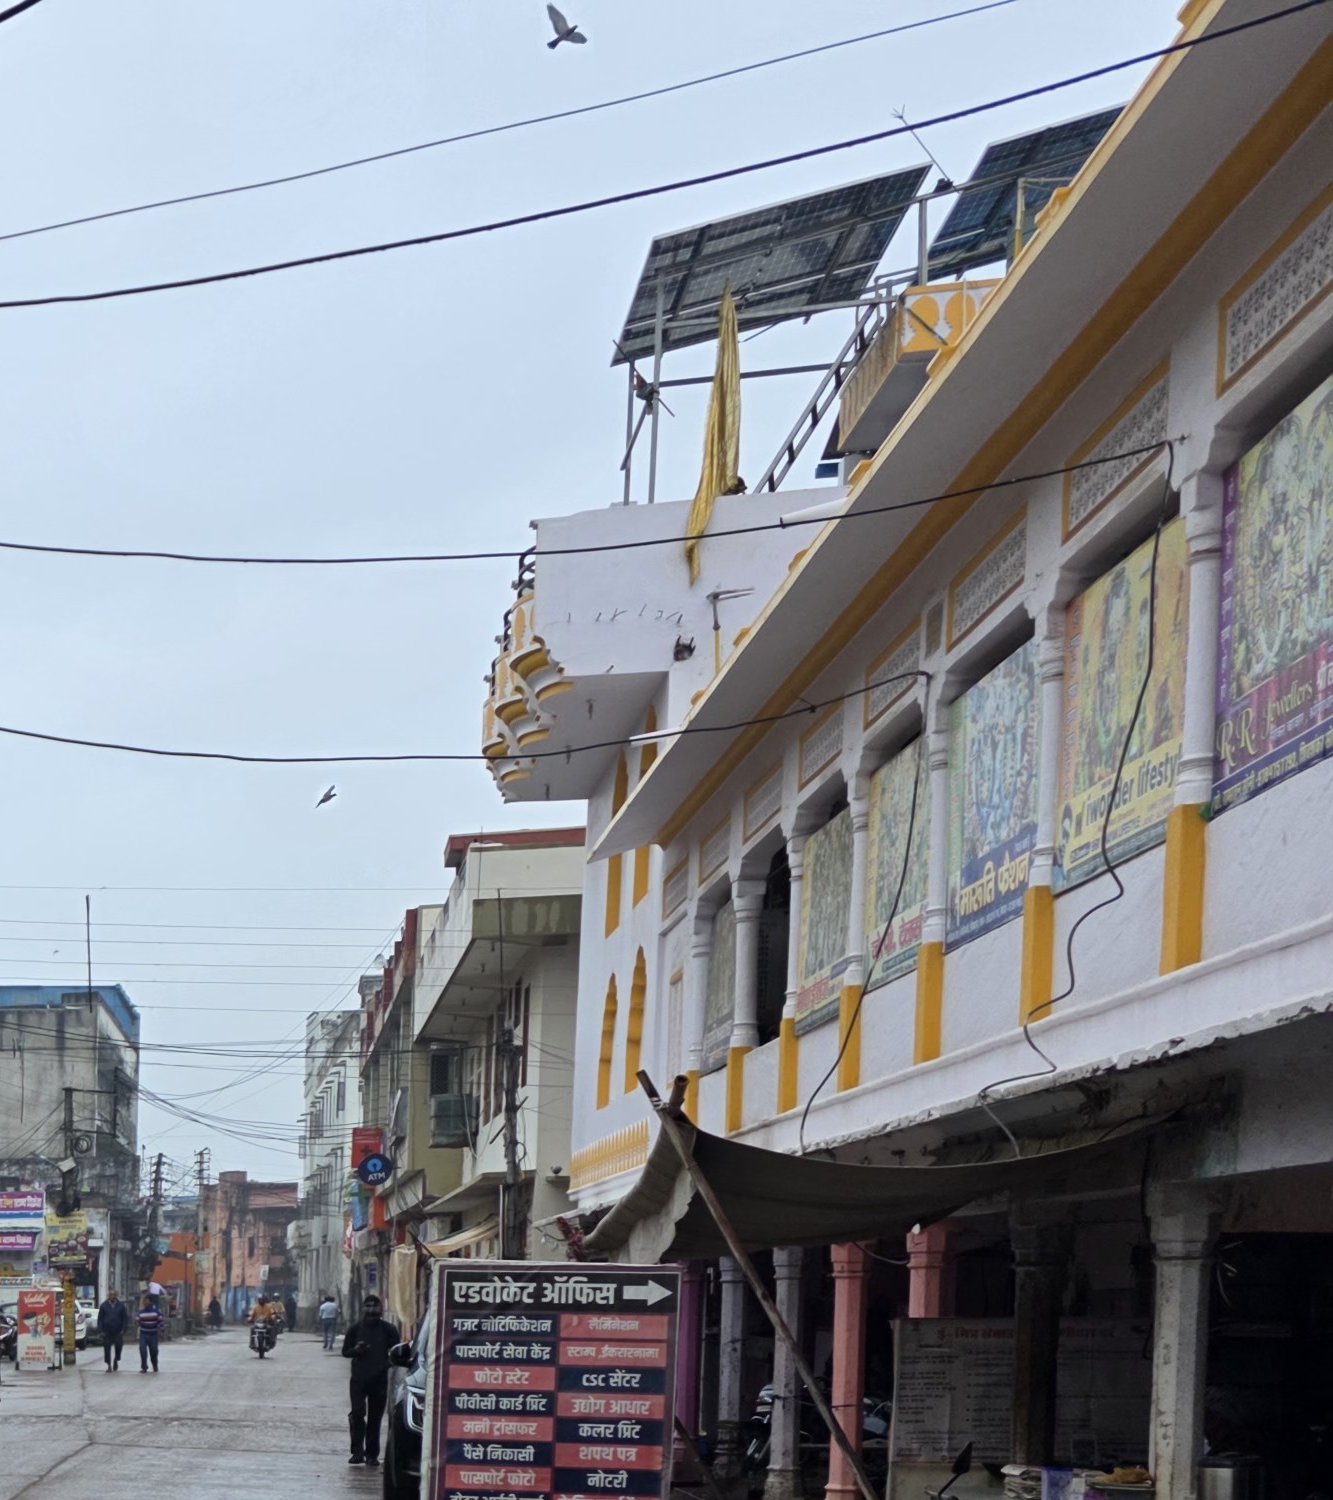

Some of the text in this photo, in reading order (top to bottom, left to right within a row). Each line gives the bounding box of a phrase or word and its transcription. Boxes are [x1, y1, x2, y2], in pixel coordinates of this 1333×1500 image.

[1136, 742, 1183, 799] lifestyl
[367, 1172, 386, 1182] ATM
[452, 1276, 618, 1305] एडवोकेट ऑफिस
[453, 1315, 553, 1333] गजट नोटिफिकेशन
[455, 1342, 501, 1359] पासपोर्ट
[502, 1342, 528, 1359] सेवा
[474, 1367, 531, 1386] फोटो स्टेट
[582, 1368, 642, 1388] CSC सेंटर
[455, 1392, 497, 1411] पीवीसी
[498, 1394, 524, 1411] कार्ड
[609, 1398, 651, 1415] आधार
[462, 1418, 491, 1435] मनी
[578, 1423, 615, 1439] कलर
[463, 1443, 535, 1463] पैसे निकासी
[578, 1446, 638, 1463] शपथ पत्र
[460, 1468, 536, 1487] पासपोर्ट फोटो
[587, 1469, 629, 1489] नोटरी
